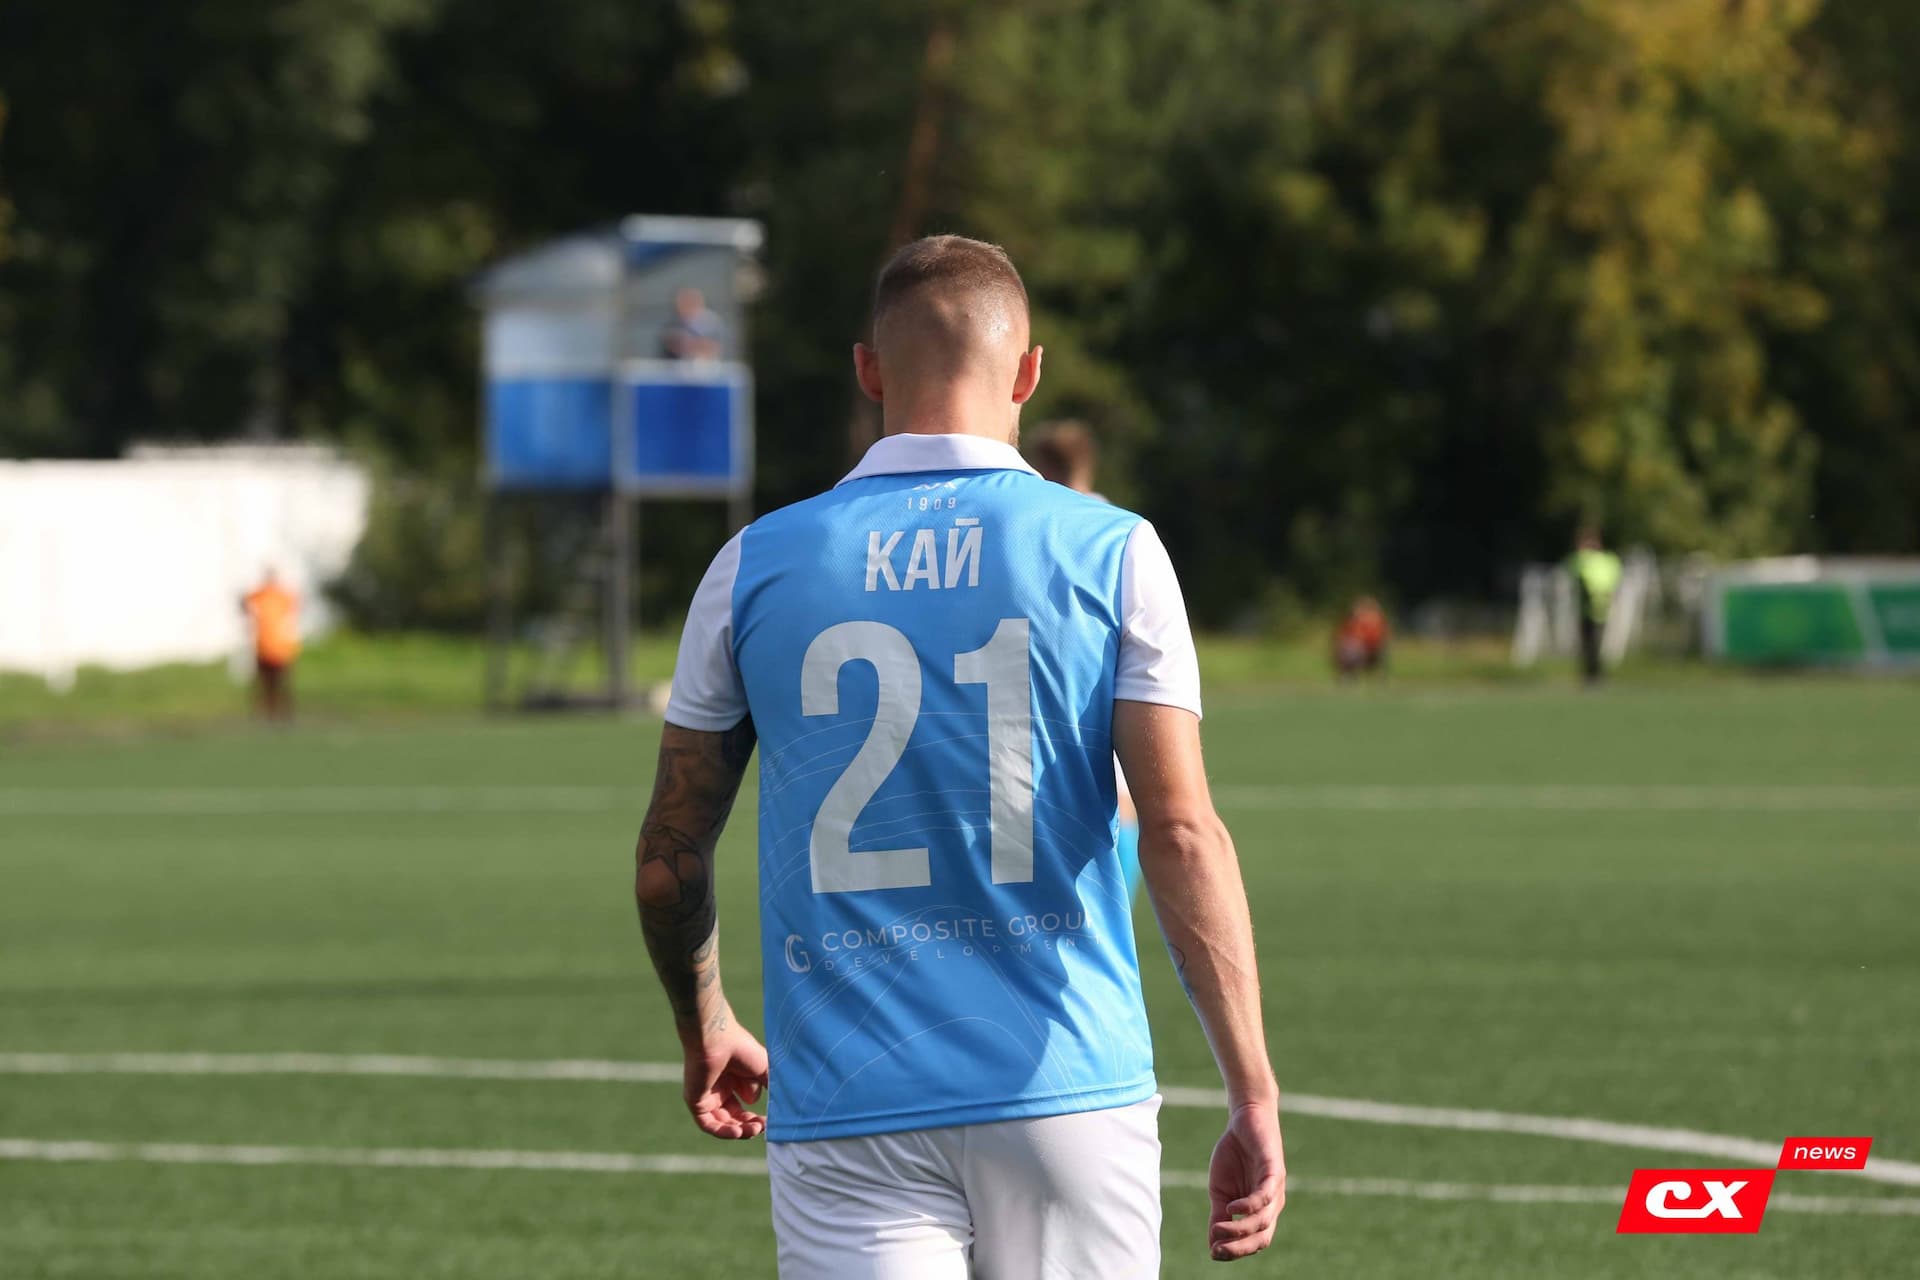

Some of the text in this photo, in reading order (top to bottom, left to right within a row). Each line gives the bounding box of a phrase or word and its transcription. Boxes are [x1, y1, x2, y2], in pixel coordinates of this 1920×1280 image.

[907, 497, 956, 511] 1909
[864, 518, 984, 592] КАЙ
[801, 618, 1033, 894] 21
[822, 919, 996, 951] COMPOSITE
